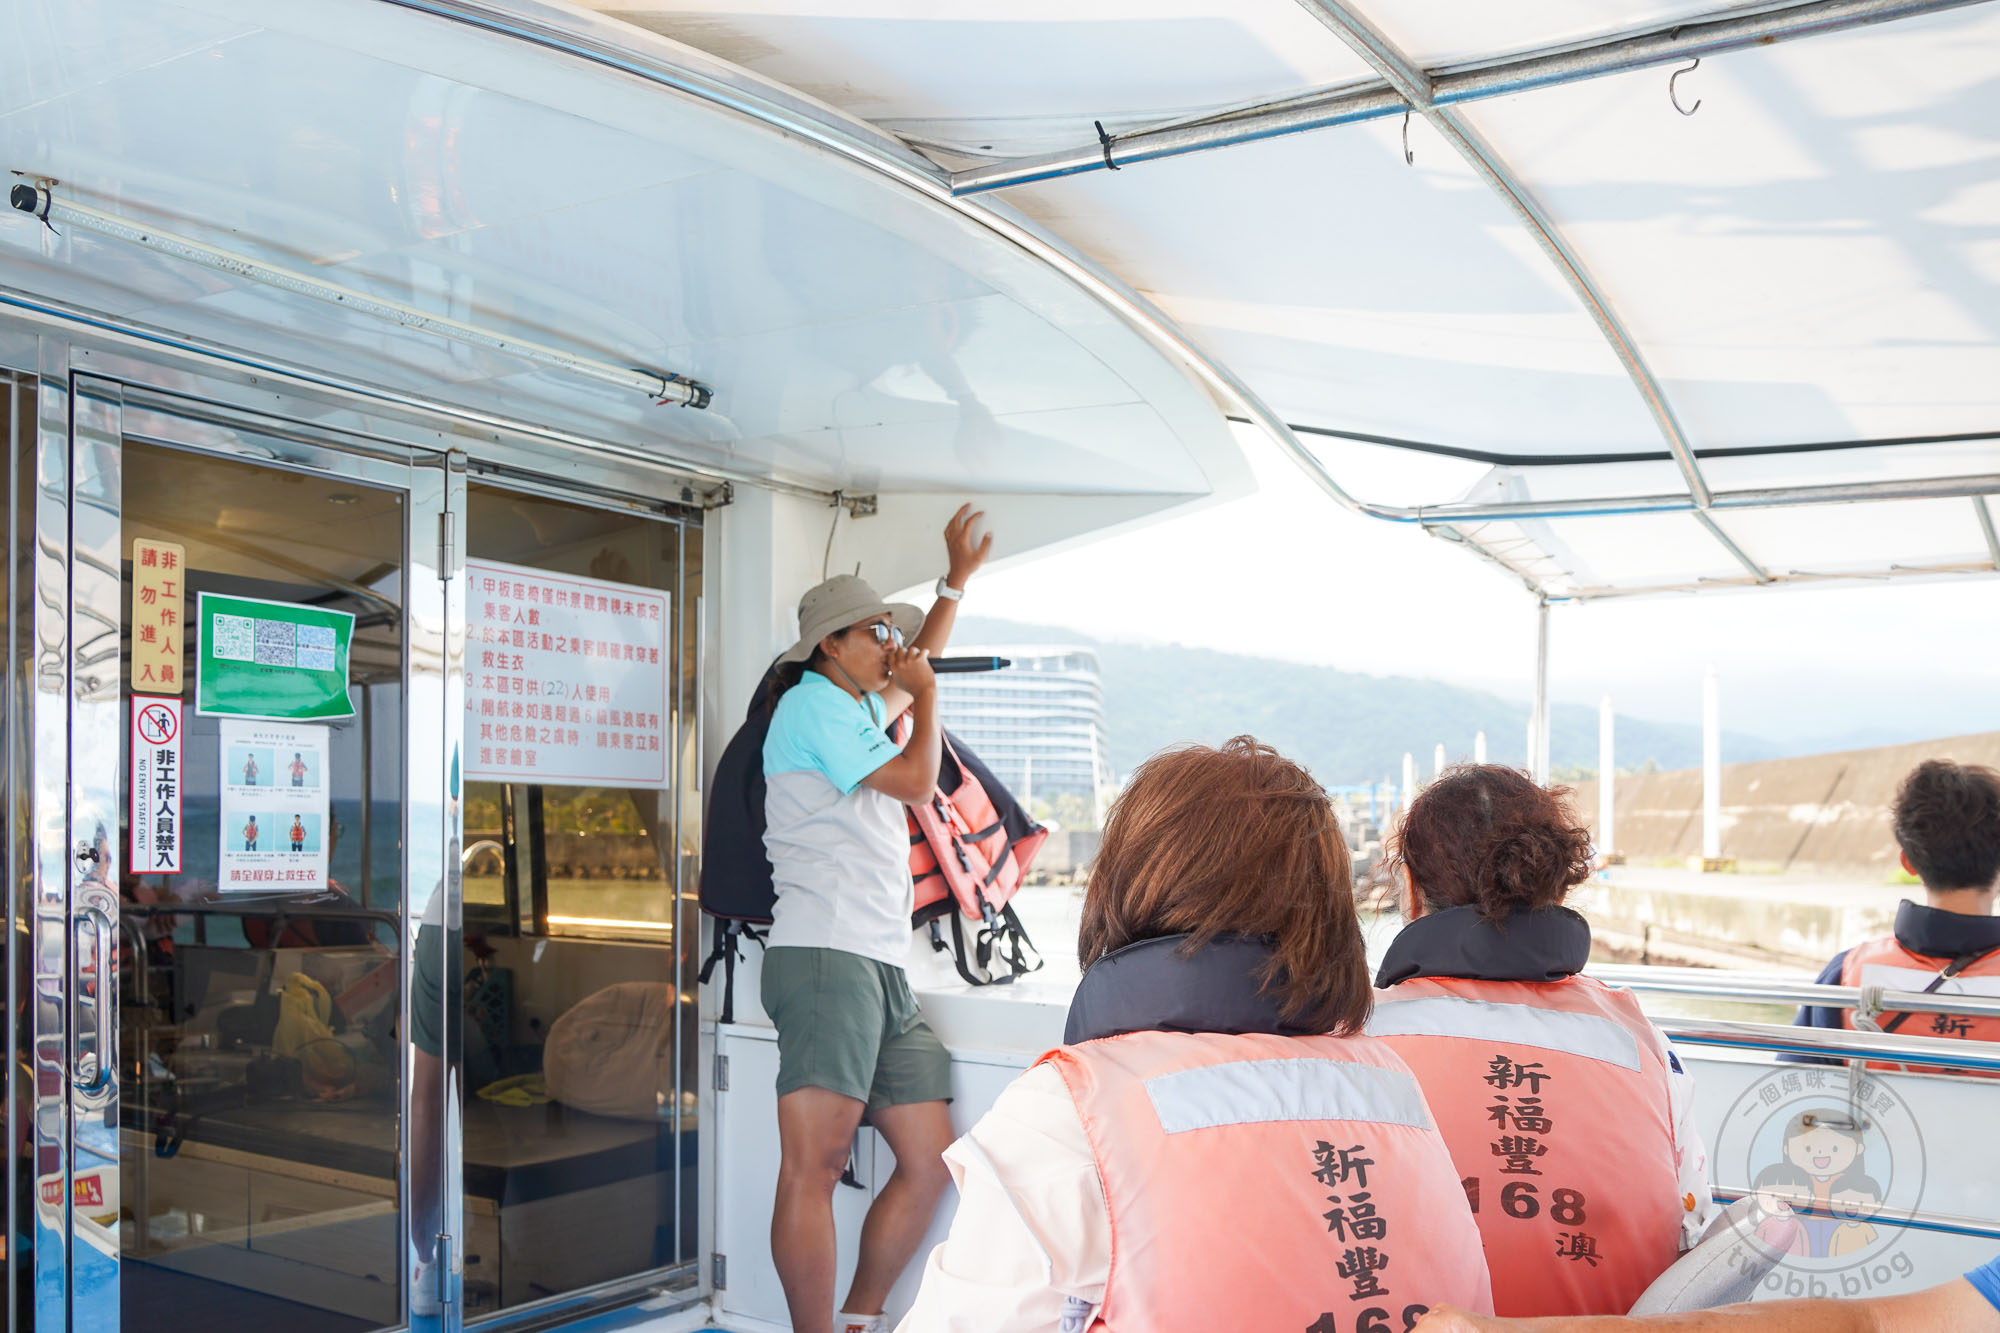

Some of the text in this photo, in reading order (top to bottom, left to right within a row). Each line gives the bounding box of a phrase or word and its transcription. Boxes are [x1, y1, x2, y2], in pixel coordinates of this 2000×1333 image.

[140, 547, 157, 683] 請勿進入
[160, 551, 178, 683] 非工作人員
[138, 759, 147, 850] NO ENTRY STAFF ONLY
[156, 748, 175, 868] 非工作人員禁入
[230, 869, 317, 882] 請全程穿上救生衣
[1483, 1054, 1552, 1176] 新福豐
[1311, 1140, 1389, 1302] 新福豐
